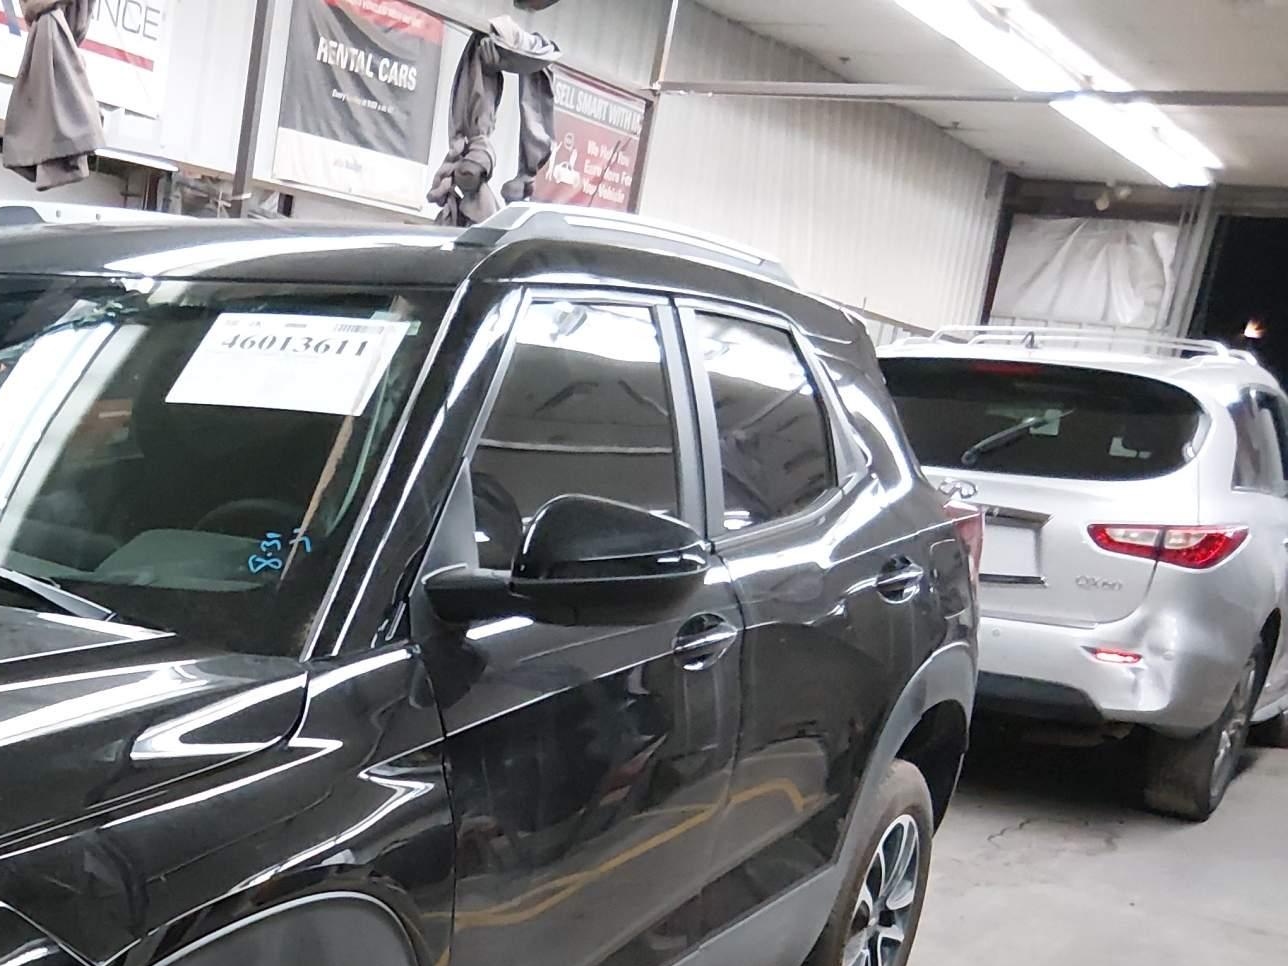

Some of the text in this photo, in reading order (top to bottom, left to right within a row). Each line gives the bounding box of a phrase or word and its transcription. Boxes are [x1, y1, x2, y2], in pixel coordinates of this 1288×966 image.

[90, 0, 161, 41] NCE
[316, 36, 417, 91] RENTAL CARS
[220, 333, 369, 357] 46013611
